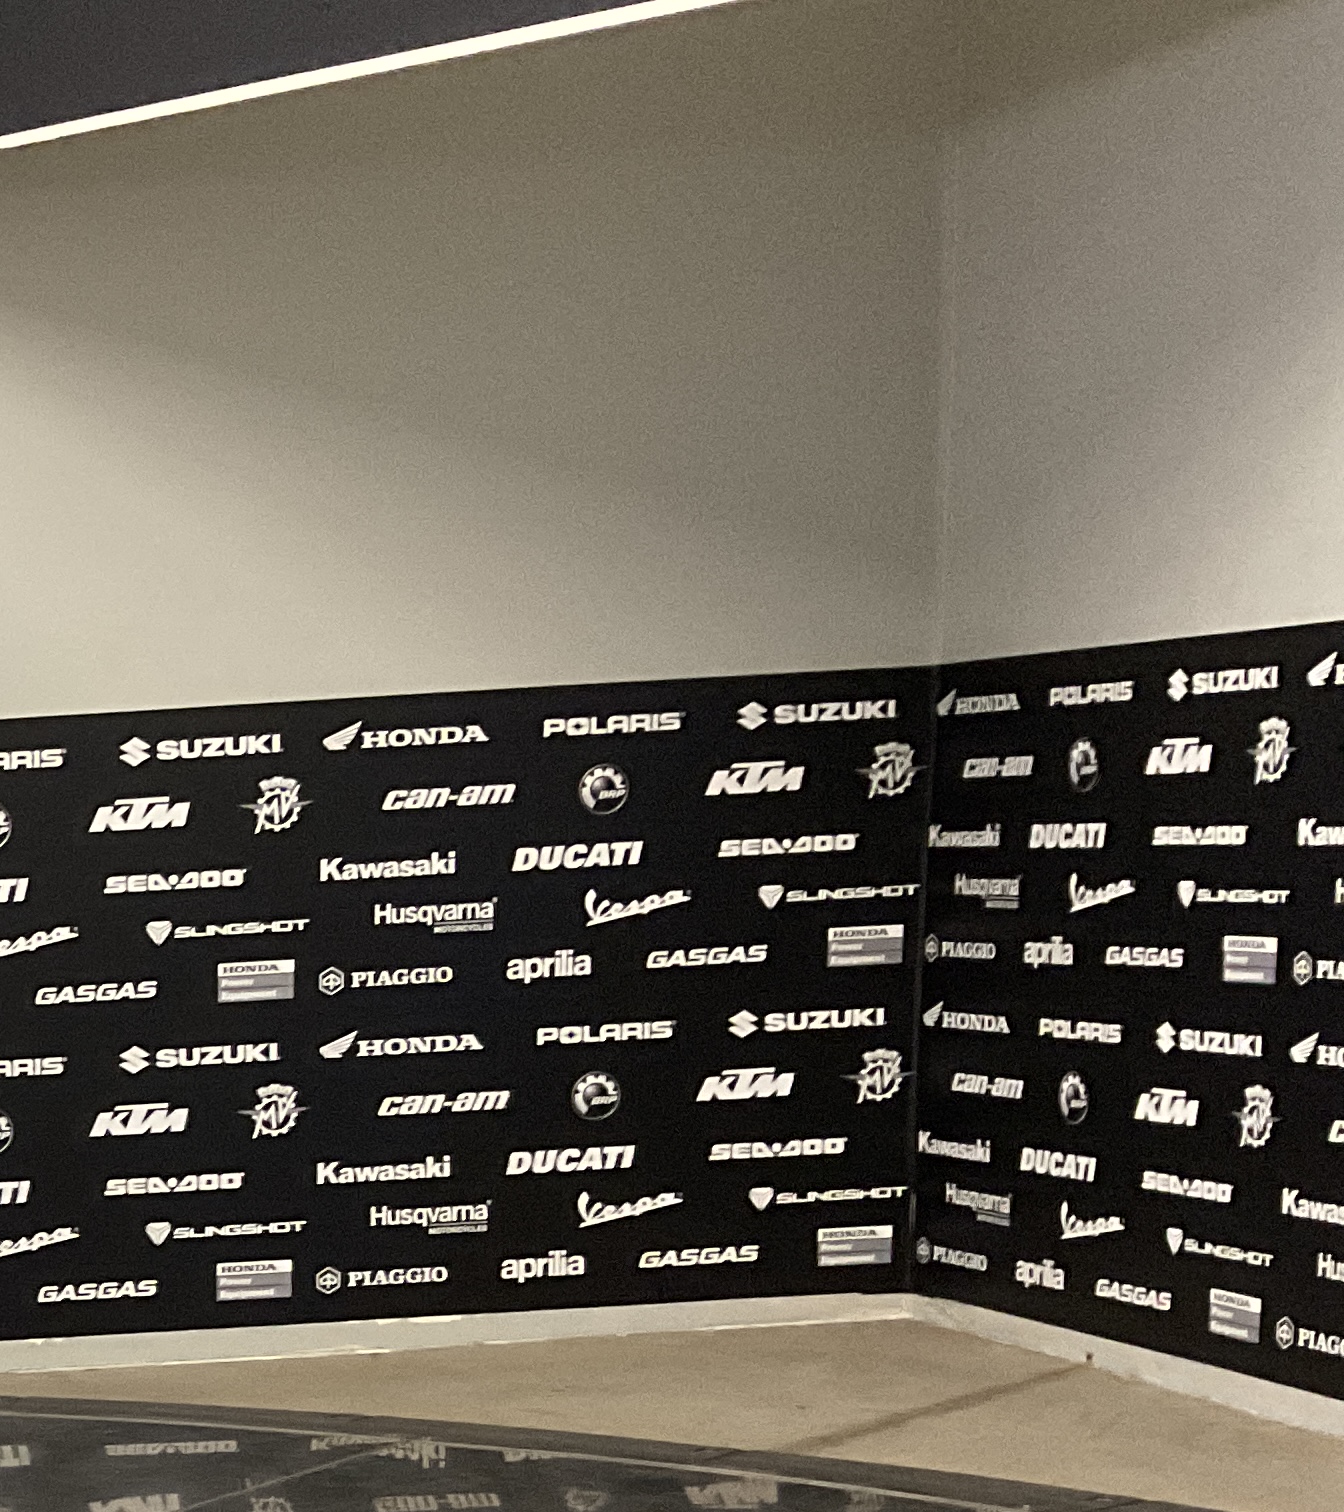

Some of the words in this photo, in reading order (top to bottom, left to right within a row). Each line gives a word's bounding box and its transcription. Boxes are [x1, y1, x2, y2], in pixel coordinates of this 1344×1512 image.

[1191, 665, 1279, 696] SUZUKI
[542, 711, 685, 738] POLARIS
[773, 699, 897, 725] SUZUKI
[156, 733, 284, 761] SUZUKI
[360, 720, 490, 750] HONDA
[1143, 736, 1214, 776] KTM
[704, 760, 806, 797] KTM
[381, 783, 517, 811] can-am
[87, 795, 191, 833] KTM
[1029, 822, 1107, 850] DUCATI
[319, 850, 457, 882] Kawasaki
[511, 840, 644, 872] DUCATI
[785, 883, 921, 903] SLINGSHOT
[373, 897, 495, 927] Husqvarna
[584, 888, 692, 927] Vespa
[173, 918, 311, 939] SLINGSHOT
[222, 964, 279, 974] HONDA
[505, 948, 593, 985] aprilia
[645, 943, 769, 969] GASGAS
[1104, 945, 1185, 968] GASGAS
[350, 966, 454, 988] PIAGGIO
[34, 980, 158, 1006] GASGAS
[536, 1020, 677, 1046] POLARIS
[763, 1007, 887, 1033] SUZUKI
[942, 1010, 1011, 1034] HONDA
[155, 1042, 281, 1068] SUZUKI
[356, 1030, 484, 1058] HONDA
[1178, 1028, 1263, 1058] SUZUKI
[695, 1066, 796, 1102] KTM
[377, 1089, 511, 1117] can-am
[1133, 1086, 1200, 1127] KTM
[88, 1102, 190, 1138] KTM
[315, 1154, 451, 1185] Kawasaki
[505, 1144, 636, 1176] DUCATI
[1019, 1146, 1097, 1183] DUCATI
[775, 1185, 908, 1205] SLINGSHOT
[369, 1200, 490, 1228] Husqvarna
[577, 1191, 684, 1229] Vespa
[172, 1220, 308, 1239] SLINGSHOT
[221, 1263, 277, 1274] HONDA
[500, 1249, 585, 1284] aprilia
[637, 1244, 760, 1269] GASGAS
[347, 1266, 449, 1288] PIAGGIO
[37, 1279, 158, 1304] GASGAS
[1094, 1278, 1172, 1311] GASGAS
